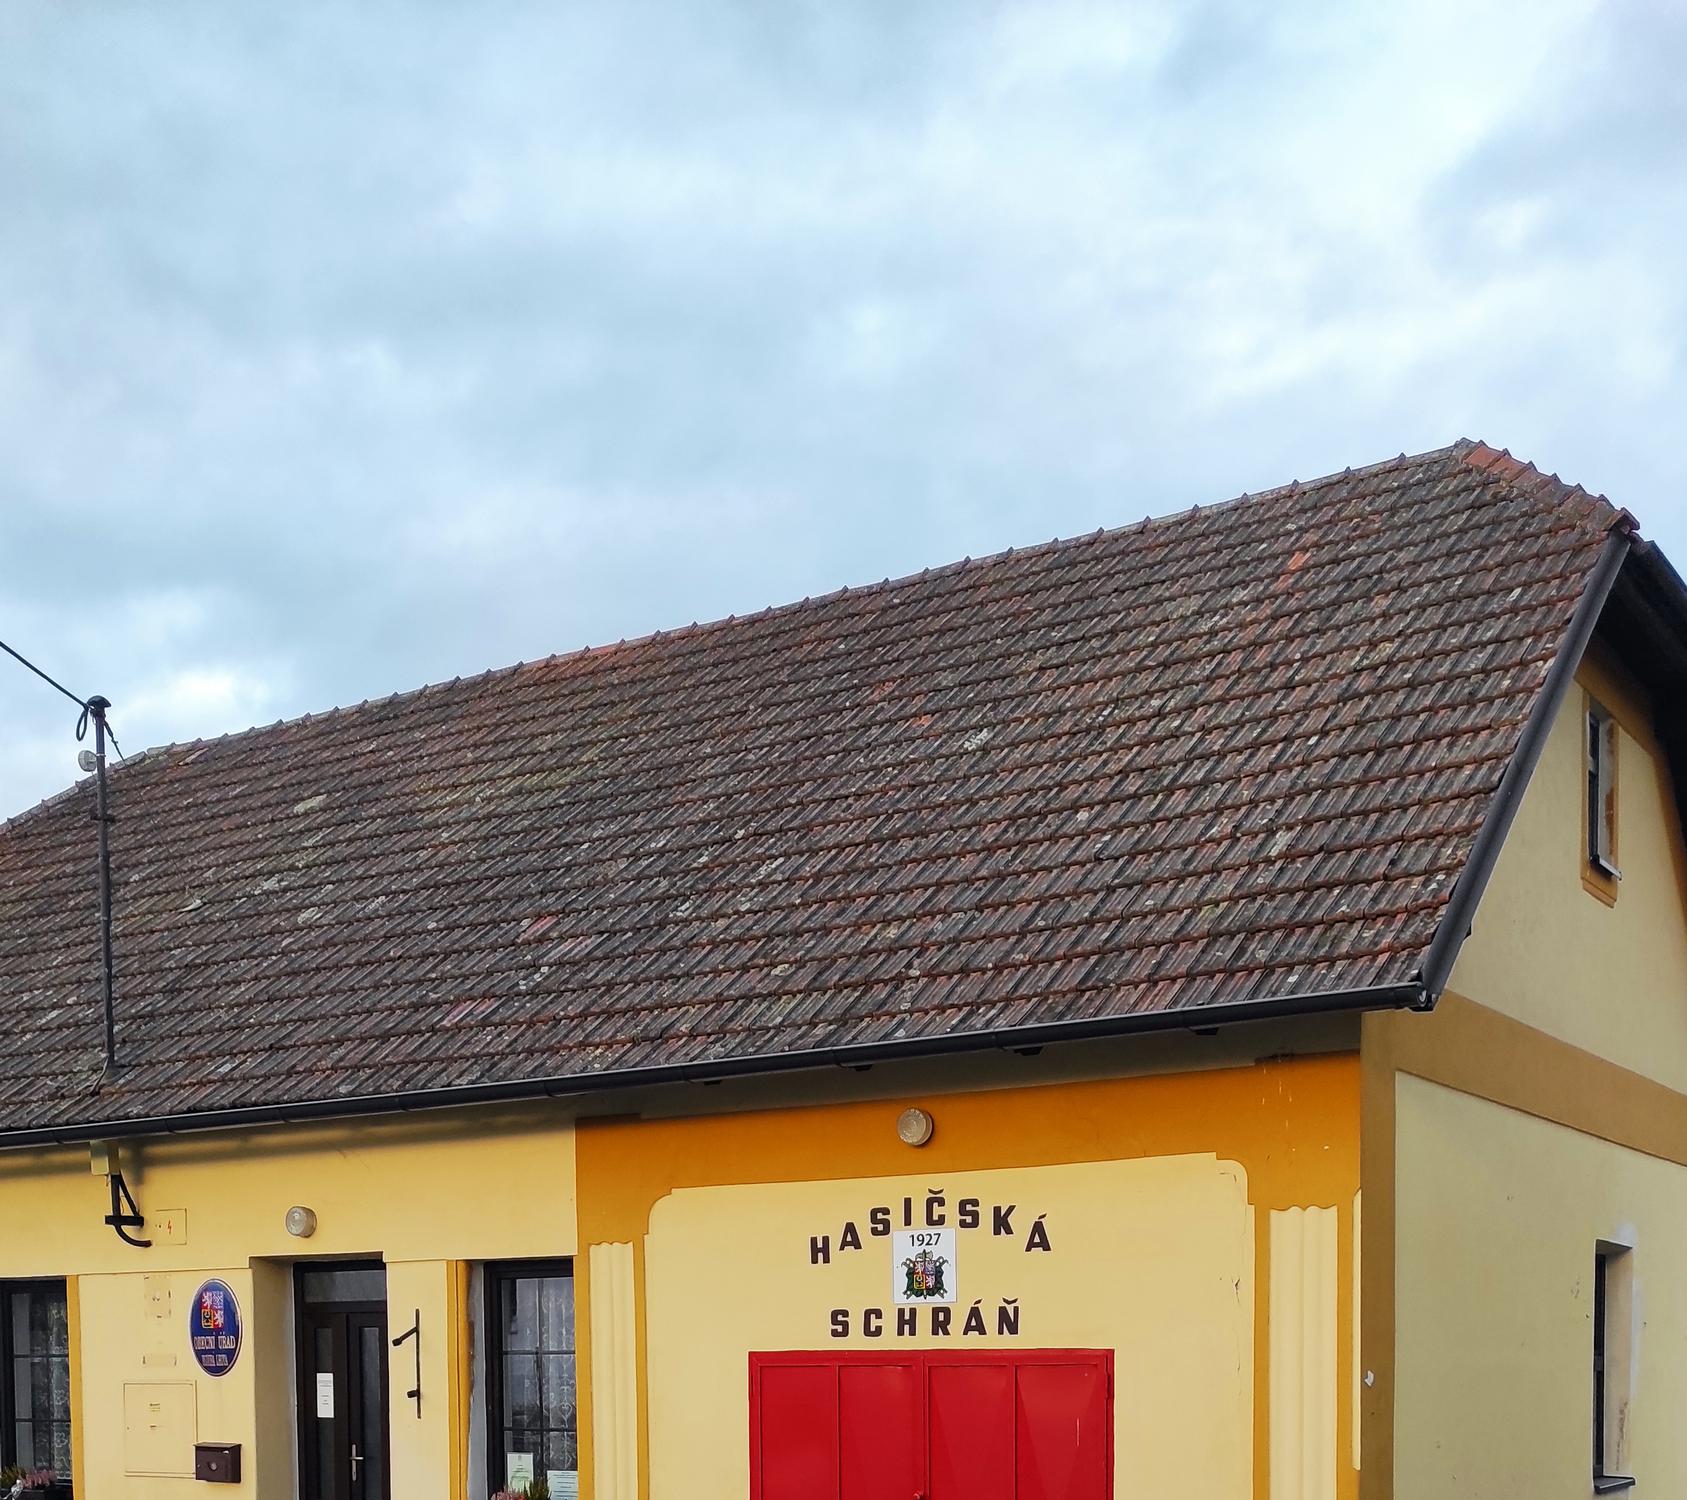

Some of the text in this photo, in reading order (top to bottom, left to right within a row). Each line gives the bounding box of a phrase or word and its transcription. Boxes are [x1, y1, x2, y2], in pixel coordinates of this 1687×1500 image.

[810, 1187, 1052, 1265] HASIČSKÁ
[909, 1232, 942, 1247] 1927
[830, 1297, 1020, 1338] SCHRÁŇ
